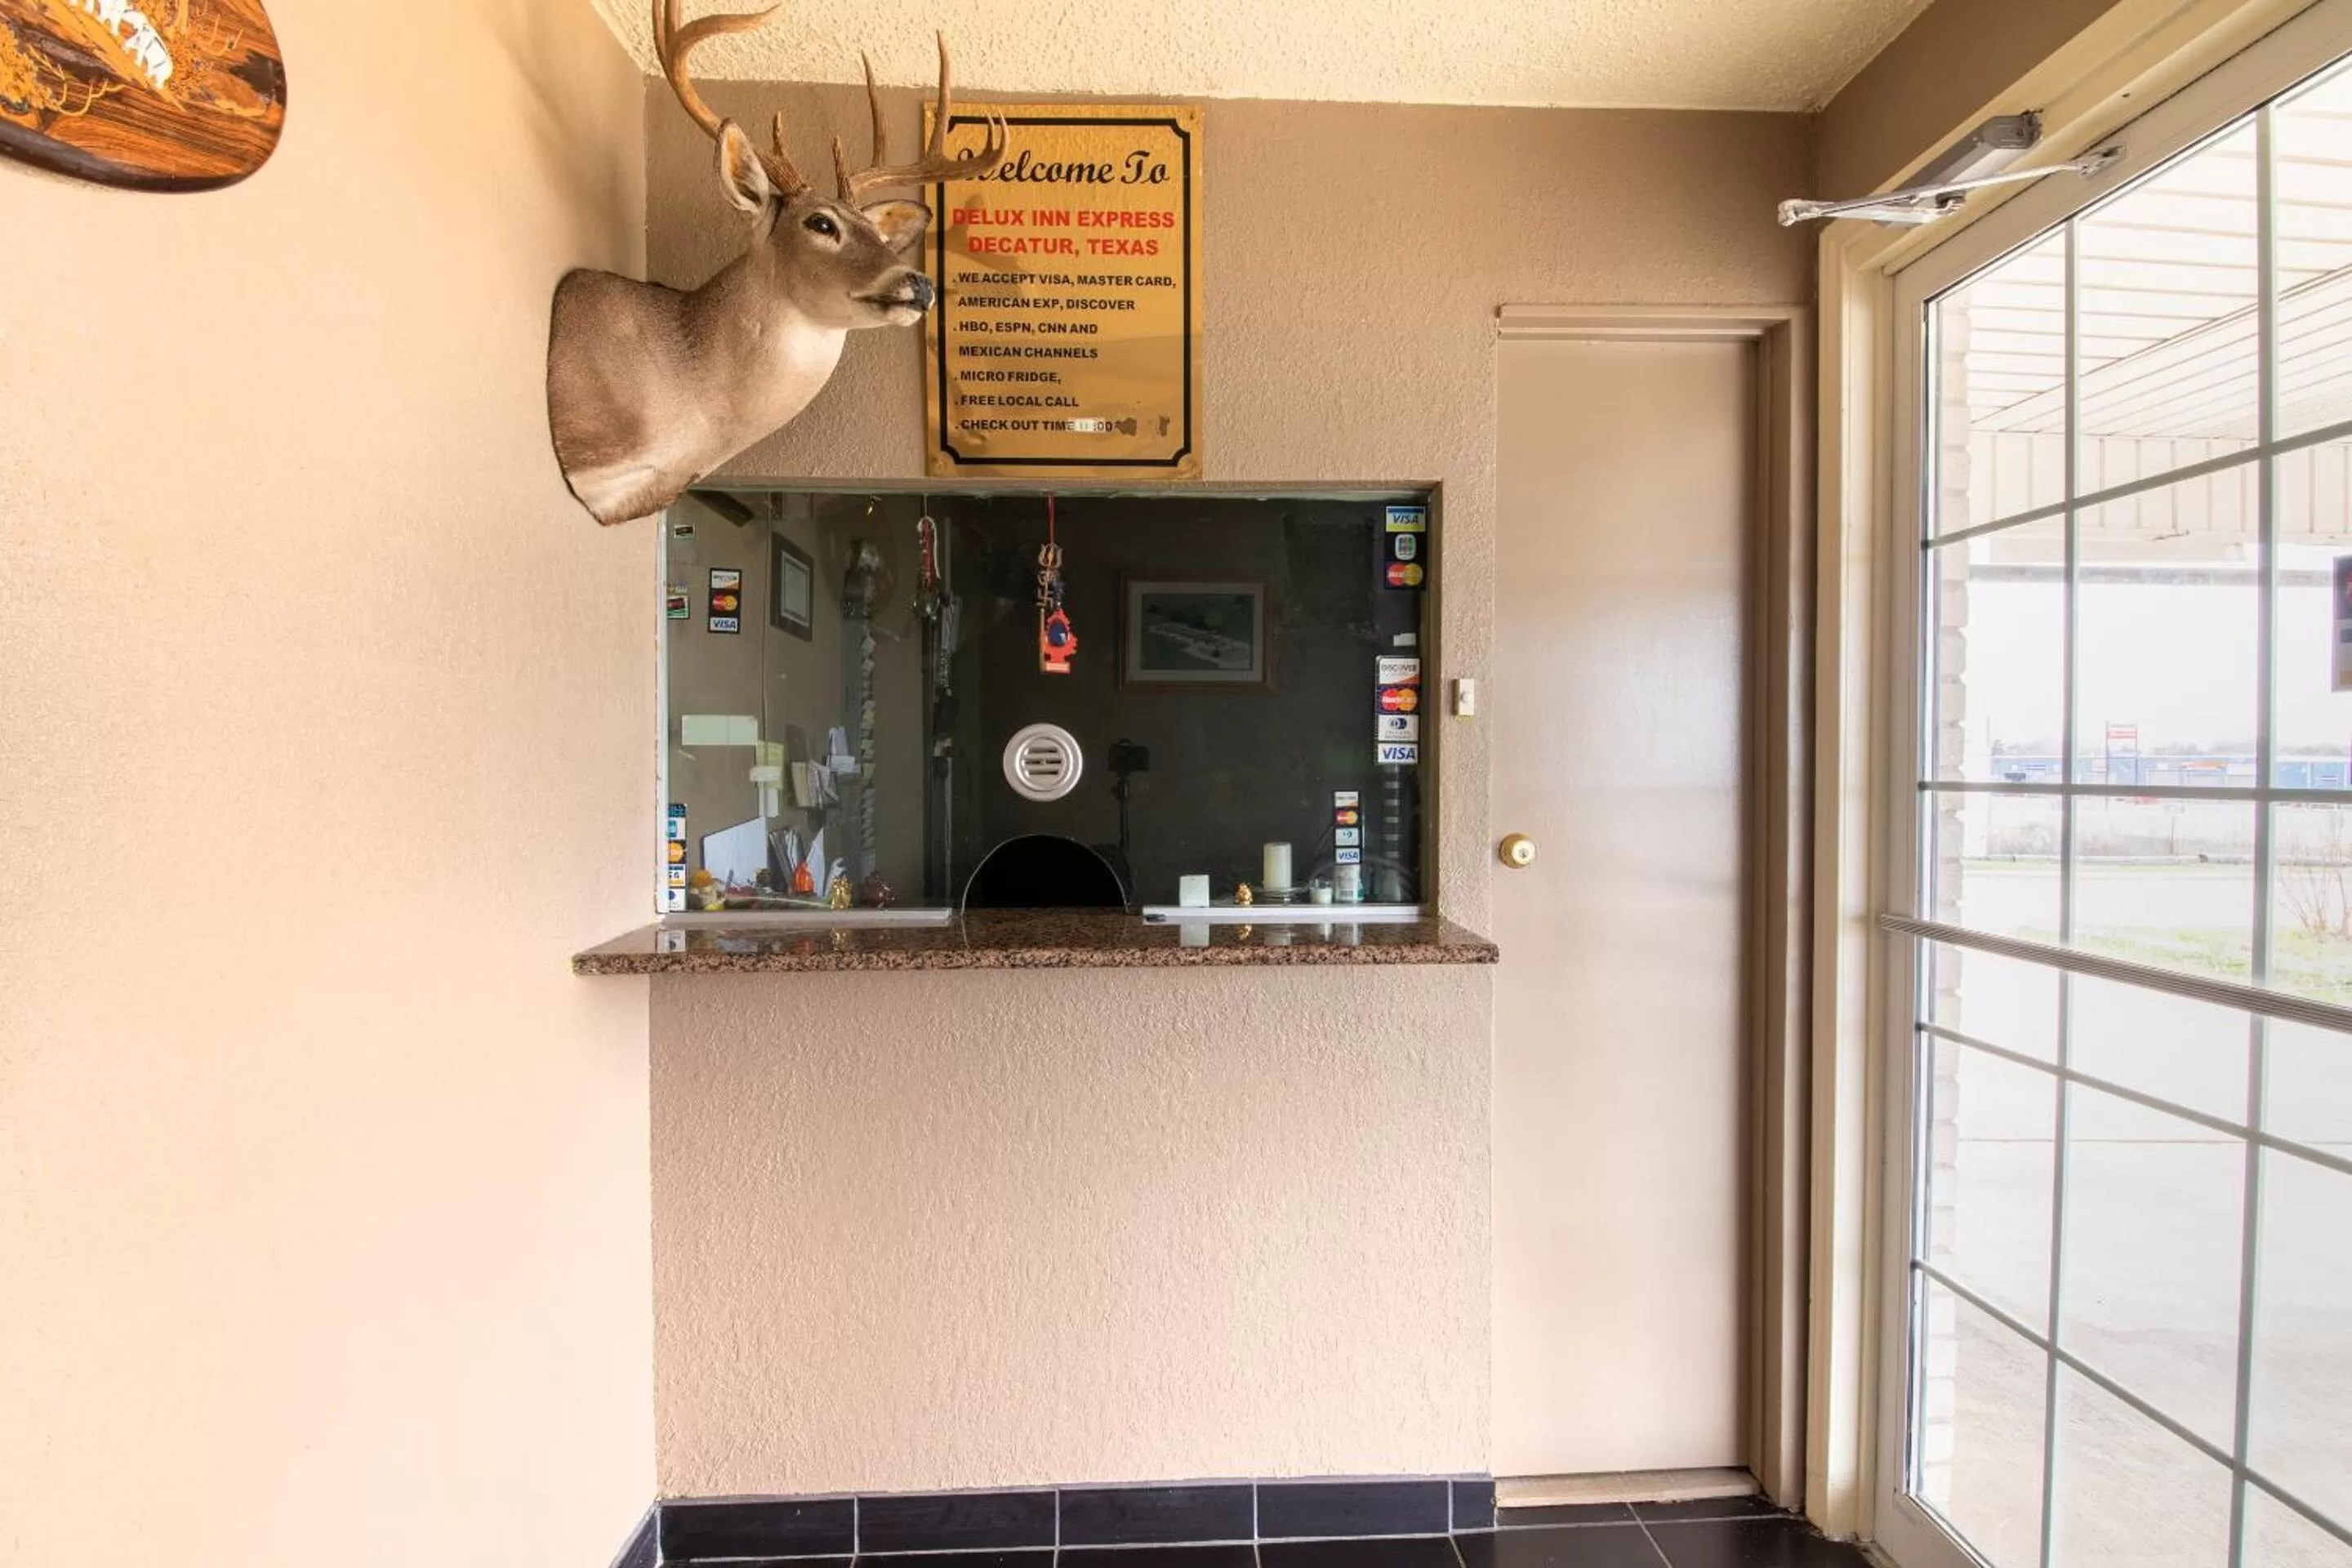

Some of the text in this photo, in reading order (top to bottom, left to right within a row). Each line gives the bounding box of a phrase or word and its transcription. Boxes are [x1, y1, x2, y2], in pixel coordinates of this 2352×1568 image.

[957, 148, 1169, 184] elcome To
[952, 209, 1175, 228] DELUX INN EXPRESS
[967, 237, 1159, 257] DECATUR, TEXAS
[958, 273, 1176, 288] WE ACCEPT VISA, MASTER CARD,
[958, 297, 1135, 310] AMERICAN EXP, DISCOVER
[959, 321, 1098, 335] HBO, ESPN, CNN AND
[959, 346, 1098, 359] MEXICAN CHANNELS
[960, 371, 1062, 385] MICRO FRIDGE,
[960, 395, 1079, 407] FREE LOCAL CALL
[960, 419, 1008, 430] CHECK
[1011, 420, 1038, 431] OUT
[1042, 421, 1075, 431] TIME
[1393, 514, 1419, 524] VISA
[713, 619, 736, 629] VISA
[1382, 747, 1416, 760] VISA
[1339, 852, 1359, 860] VISA
